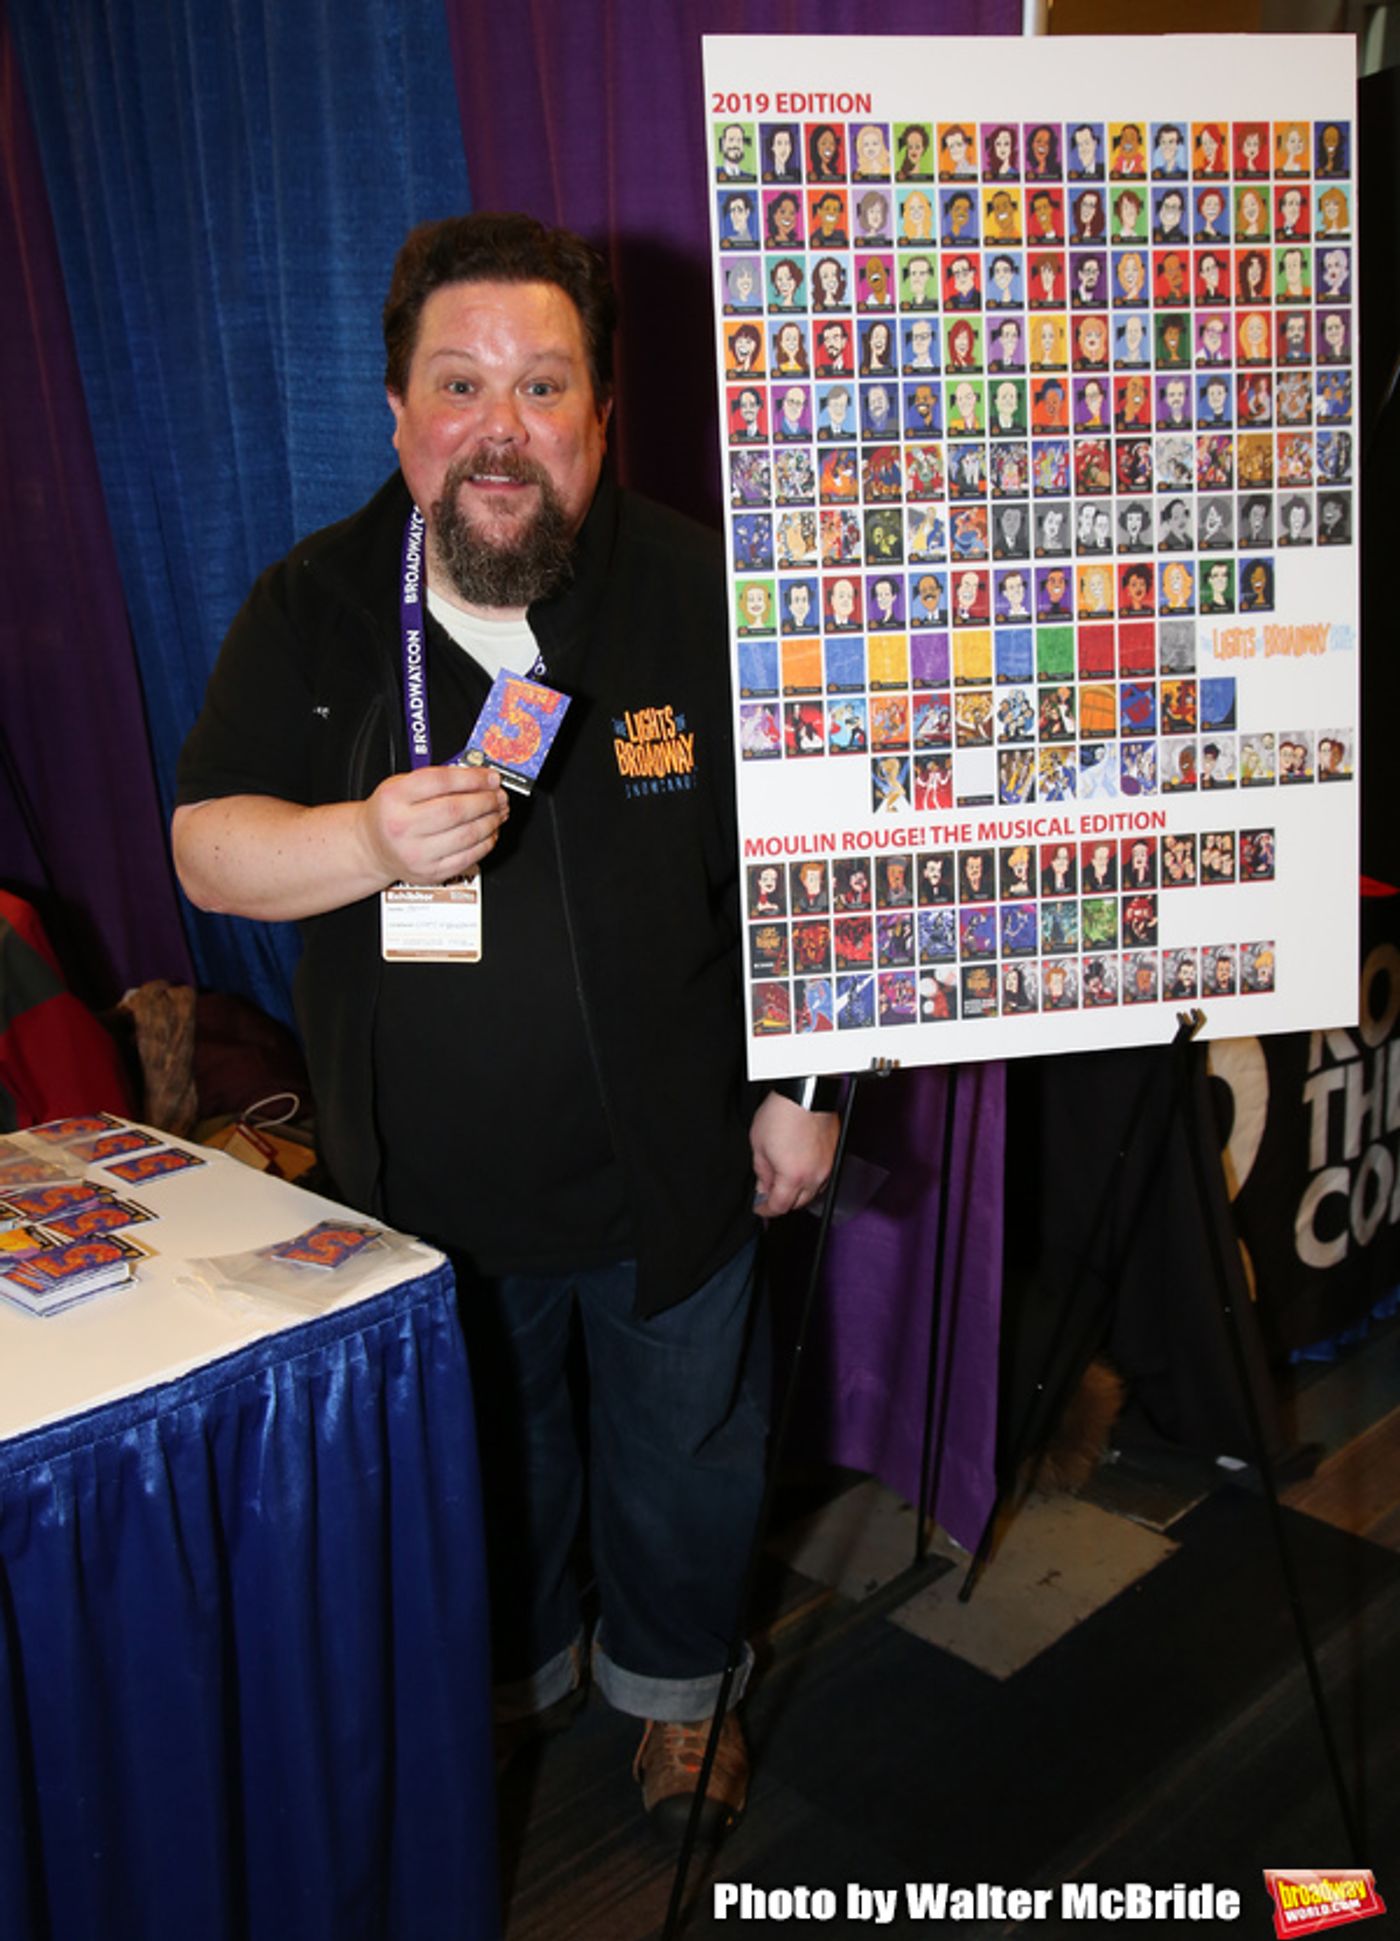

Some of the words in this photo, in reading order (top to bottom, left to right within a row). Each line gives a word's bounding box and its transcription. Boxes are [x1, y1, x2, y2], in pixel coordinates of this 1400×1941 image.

[712, 93, 770, 113] 2019
[775, 93, 872, 113] EDITION
[407, 630, 429, 754] BROADWAYCON
[624, 704, 675, 744] LIGHTS
[614, 733, 695, 778] BROADWAY
[744, 833, 837, 857] MOULIN
[842, 827, 926, 851] ROUGE!
[930, 823, 972, 844] THE
[978, 816, 1075, 841] MUSICAL
[1080, 811, 1166, 834] EDITION
[1295, 1143, 1400, 1269] CO
